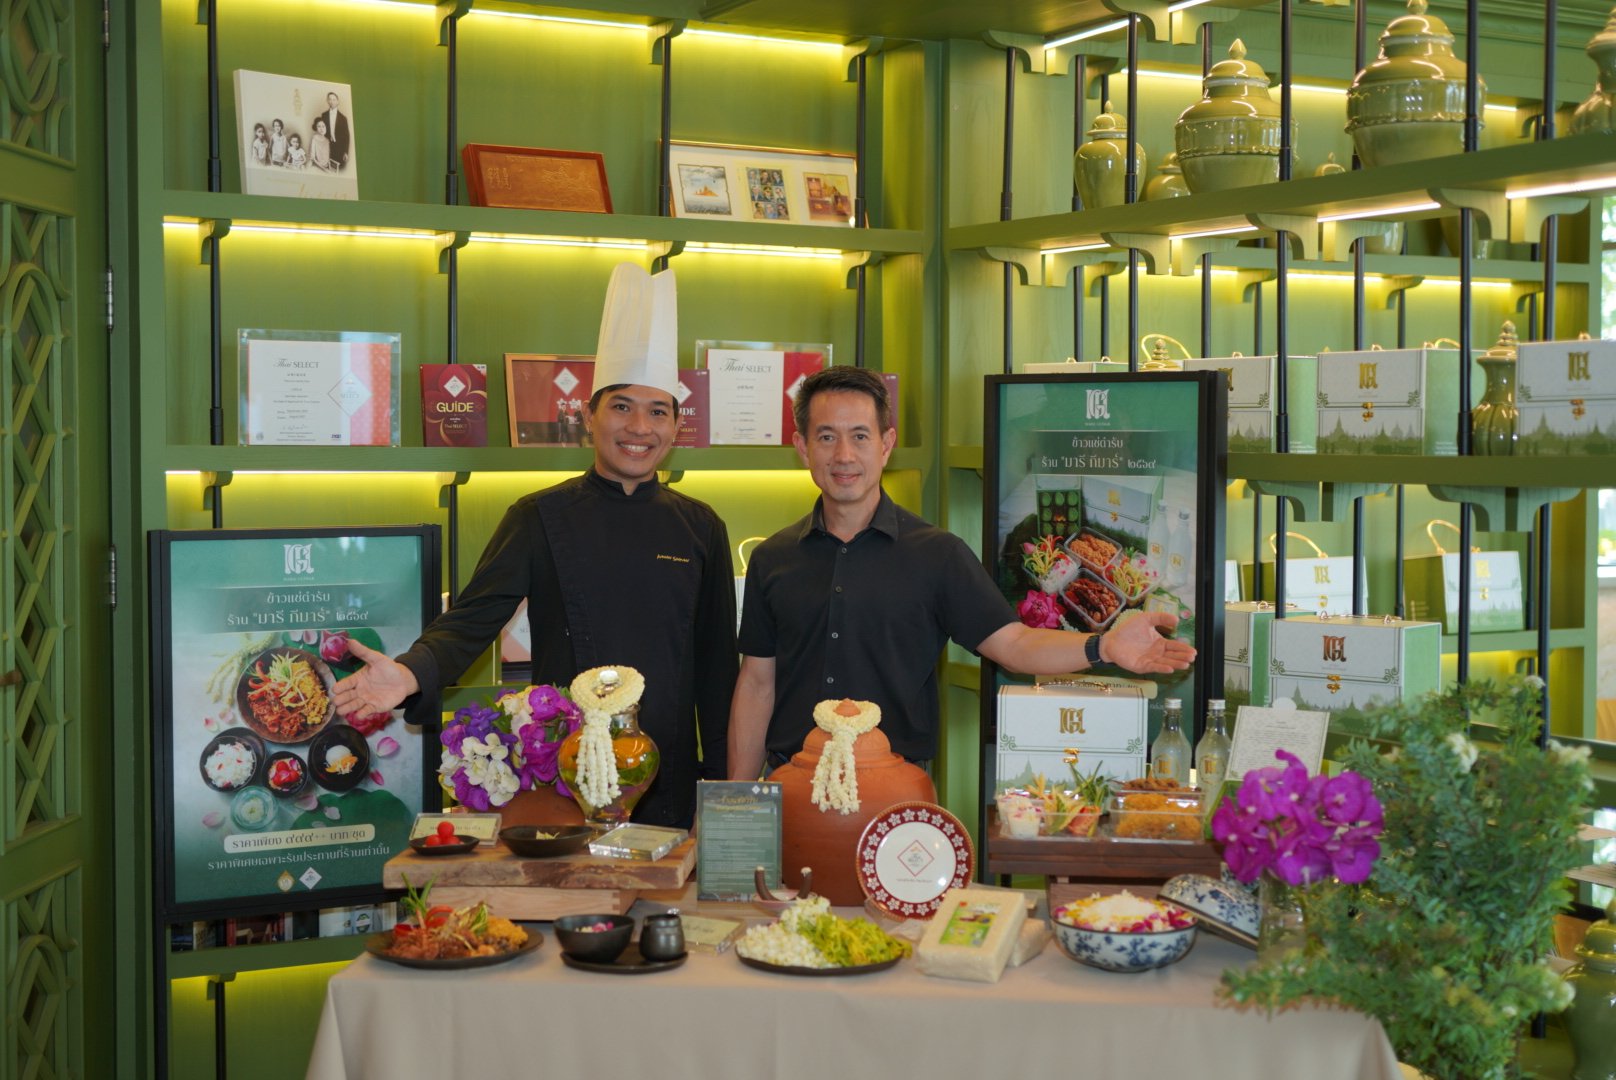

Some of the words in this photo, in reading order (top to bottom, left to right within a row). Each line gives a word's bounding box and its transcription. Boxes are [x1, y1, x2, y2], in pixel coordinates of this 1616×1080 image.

[293, 361, 321, 369] SELECT
[745, 365, 773, 374] SELECT
[436, 401, 474, 413] GUIDE
[1041, 456, 1058, 468] ร้าน
[227, 613, 249, 626] ร้าน
[232, 836, 282, 850] ราคาเพียง
